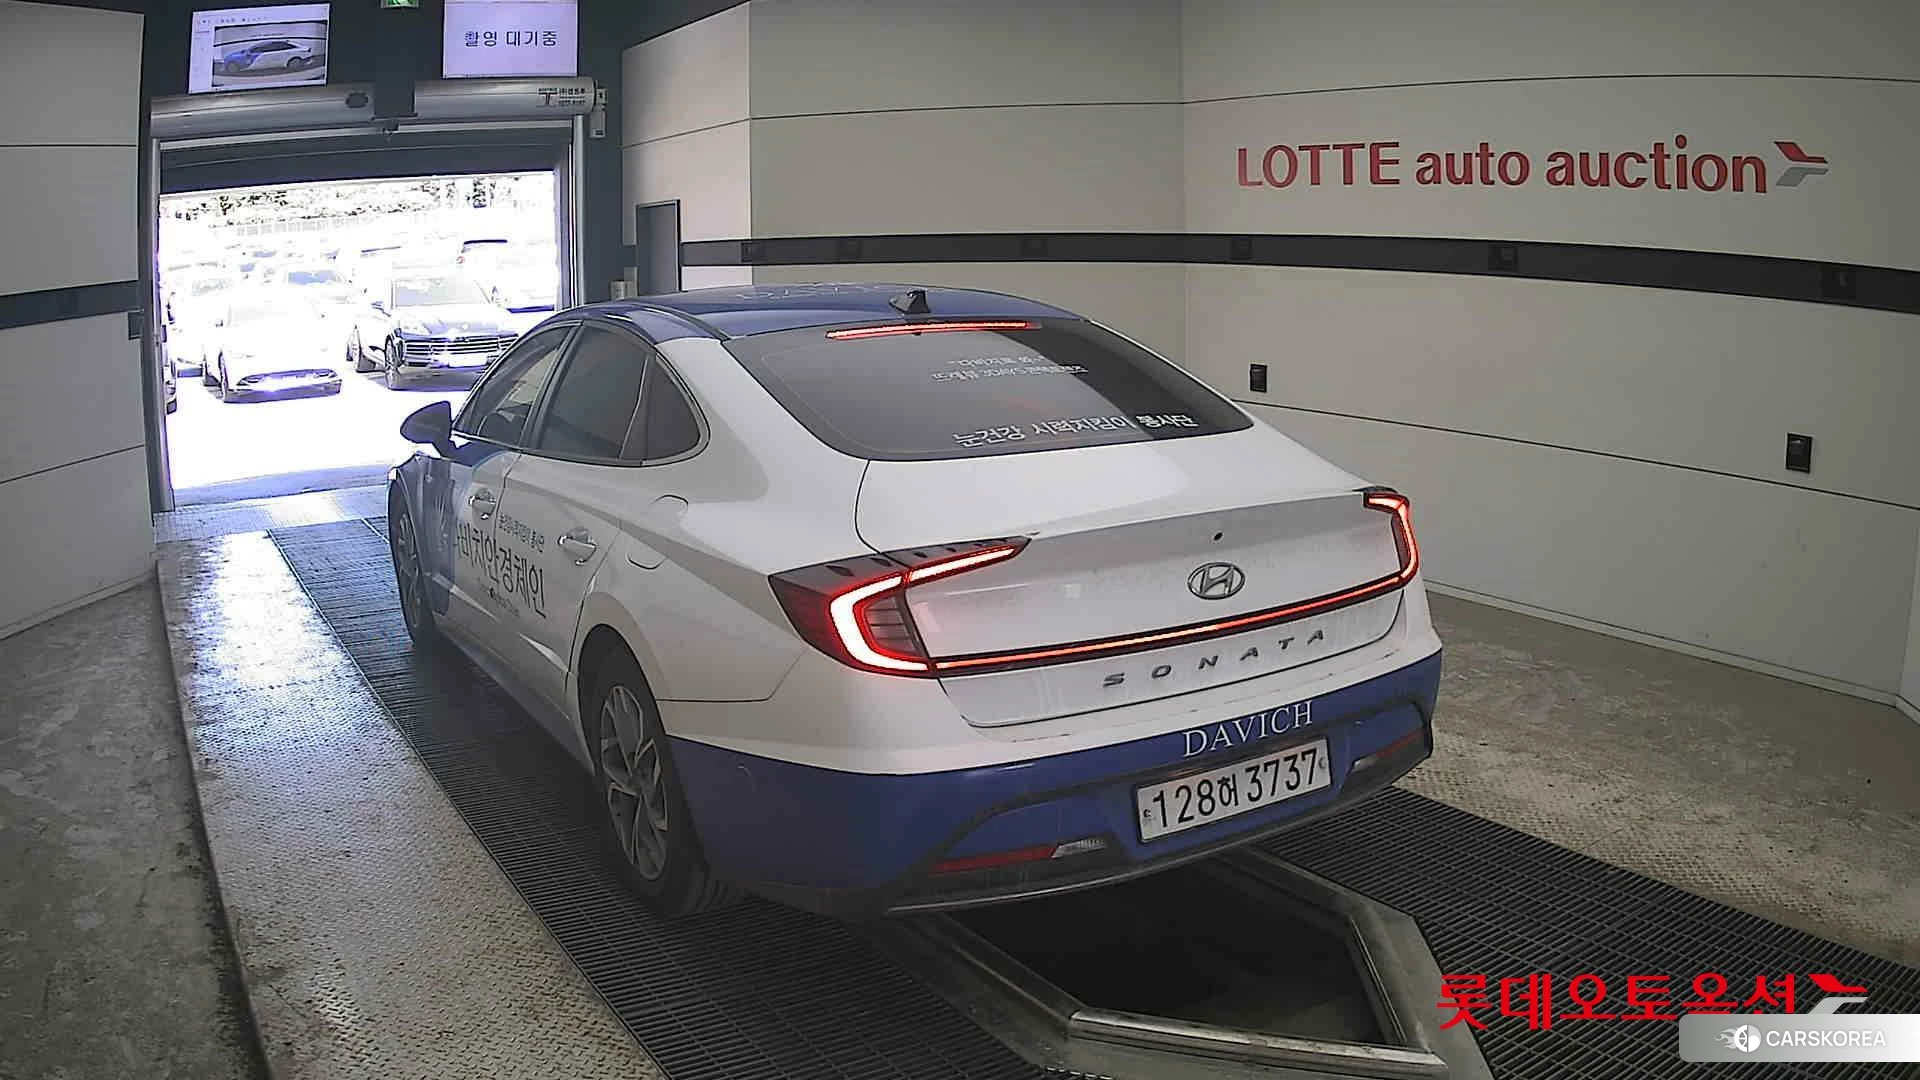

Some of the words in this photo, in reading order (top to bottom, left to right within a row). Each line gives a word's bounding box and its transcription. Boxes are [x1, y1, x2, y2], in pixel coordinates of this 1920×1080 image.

[506, 30, 557, 47] 대기중
[1237, 140, 1400, 189] LOTTE
[1415, 141, 1530, 187] auto
[1545, 134, 1768, 195] auction
[953, 424, 1026, 449] 눈건강
[1031, 415, 1138, 436] 시력지킴이
[1136, 413, 1201, 429] 봉사단
[454, 521, 547, 620] 비치안경체인
[1102, 630, 1324, 687] SONATA
[1182, 700, 1314, 758] DAVICH
[1244, 748, 1319, 803] 3737
